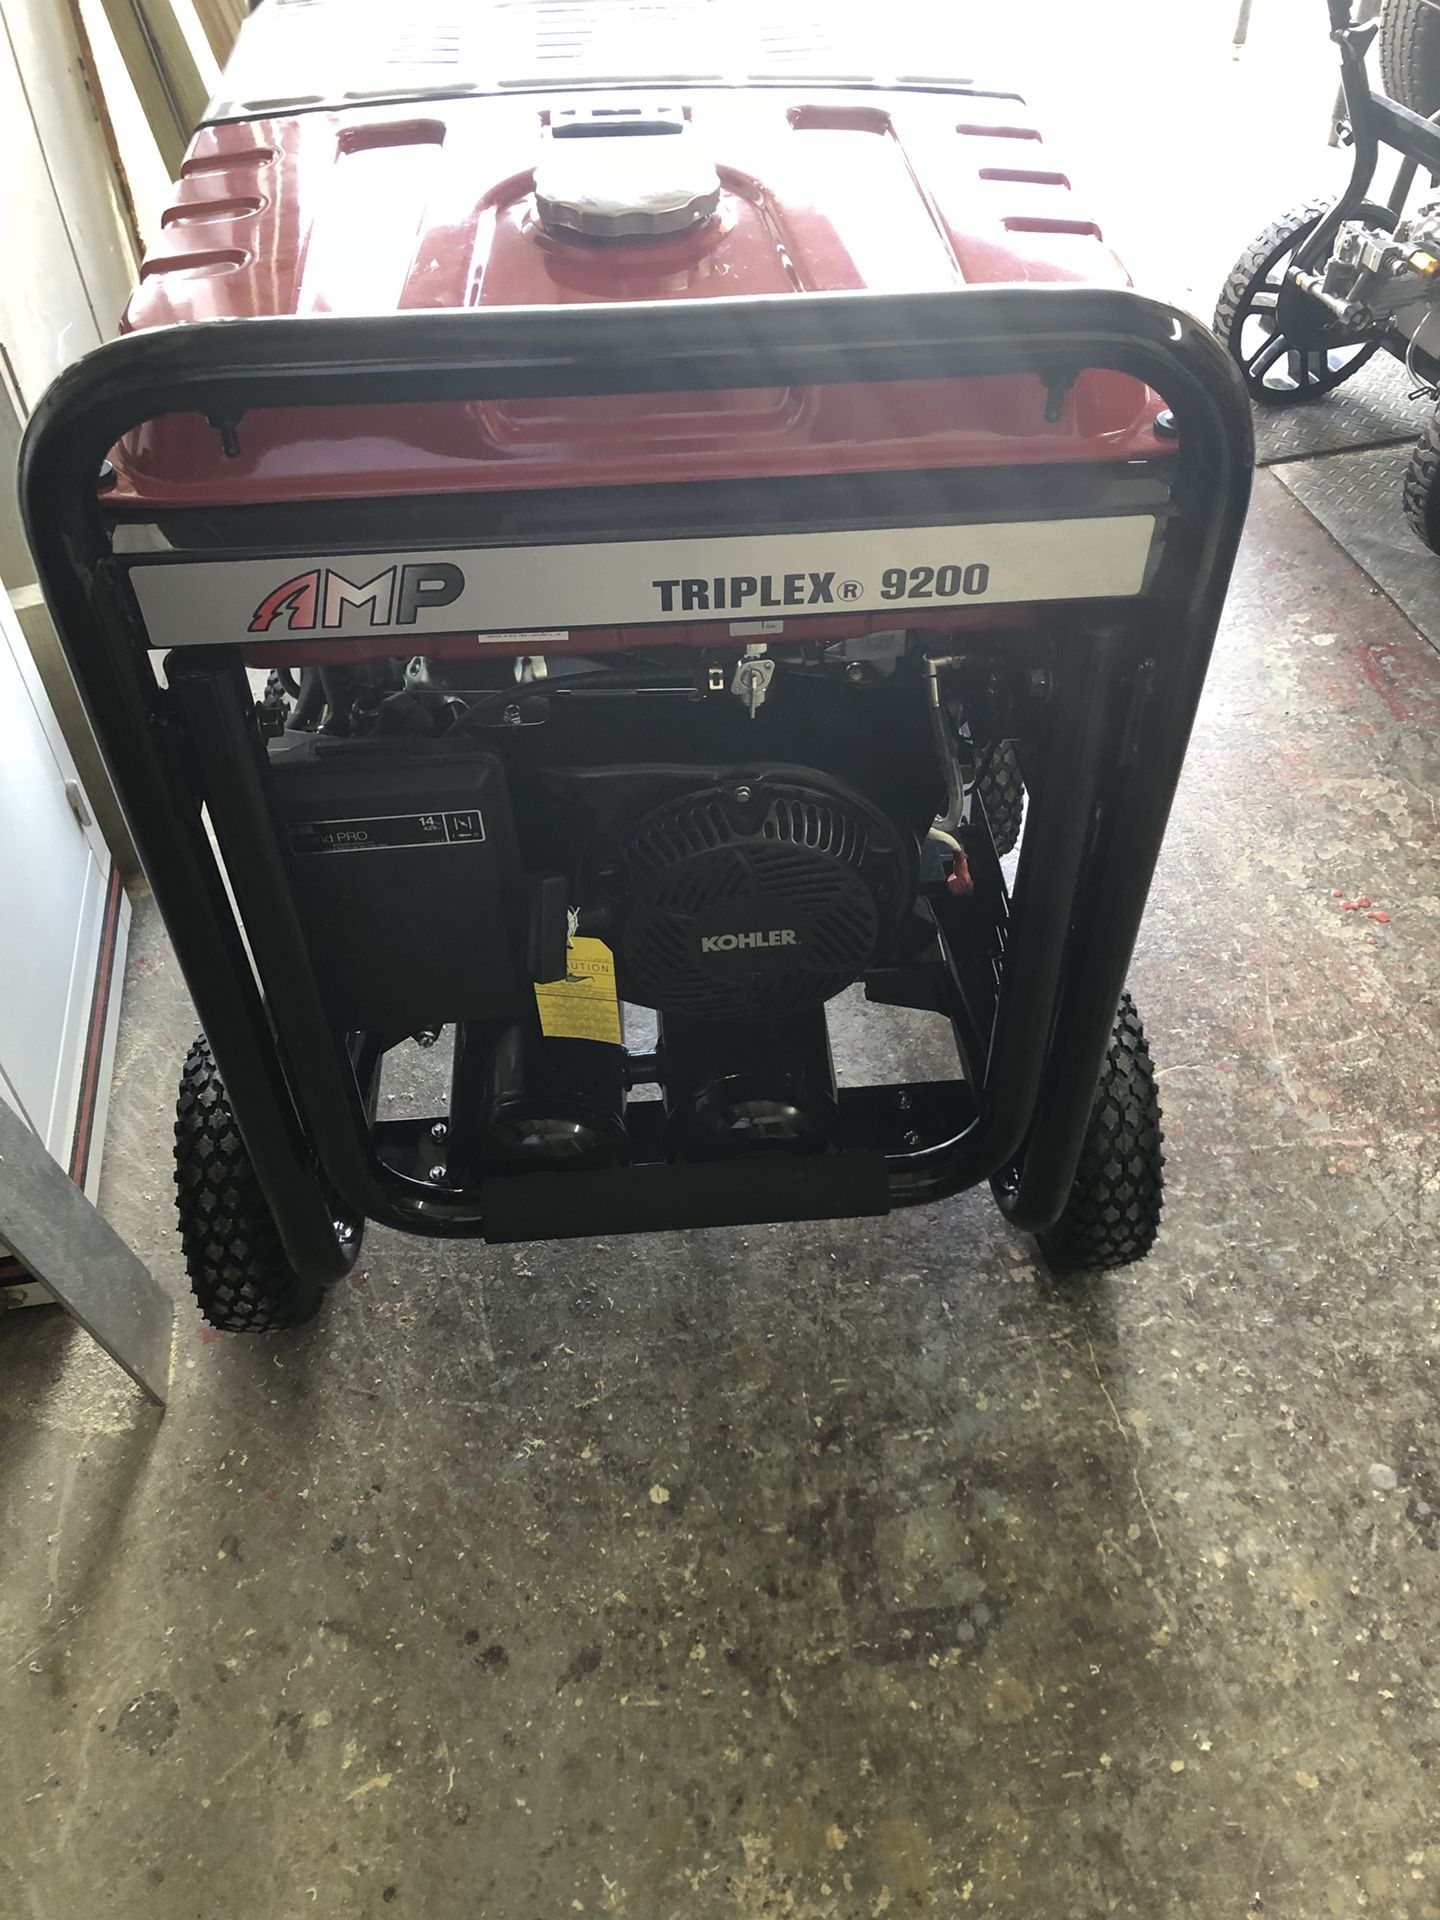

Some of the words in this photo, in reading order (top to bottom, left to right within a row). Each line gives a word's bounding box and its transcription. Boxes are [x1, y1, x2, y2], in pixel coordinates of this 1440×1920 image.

[880, 563, 990, 600] 9200
[247, 562, 466, 633] AMP
[418, 816, 435, 827] 14
[336, 830, 369, 843] PRO
[702, 929, 797, 953] KOHLER
[566, 961, 610, 973] UTION
